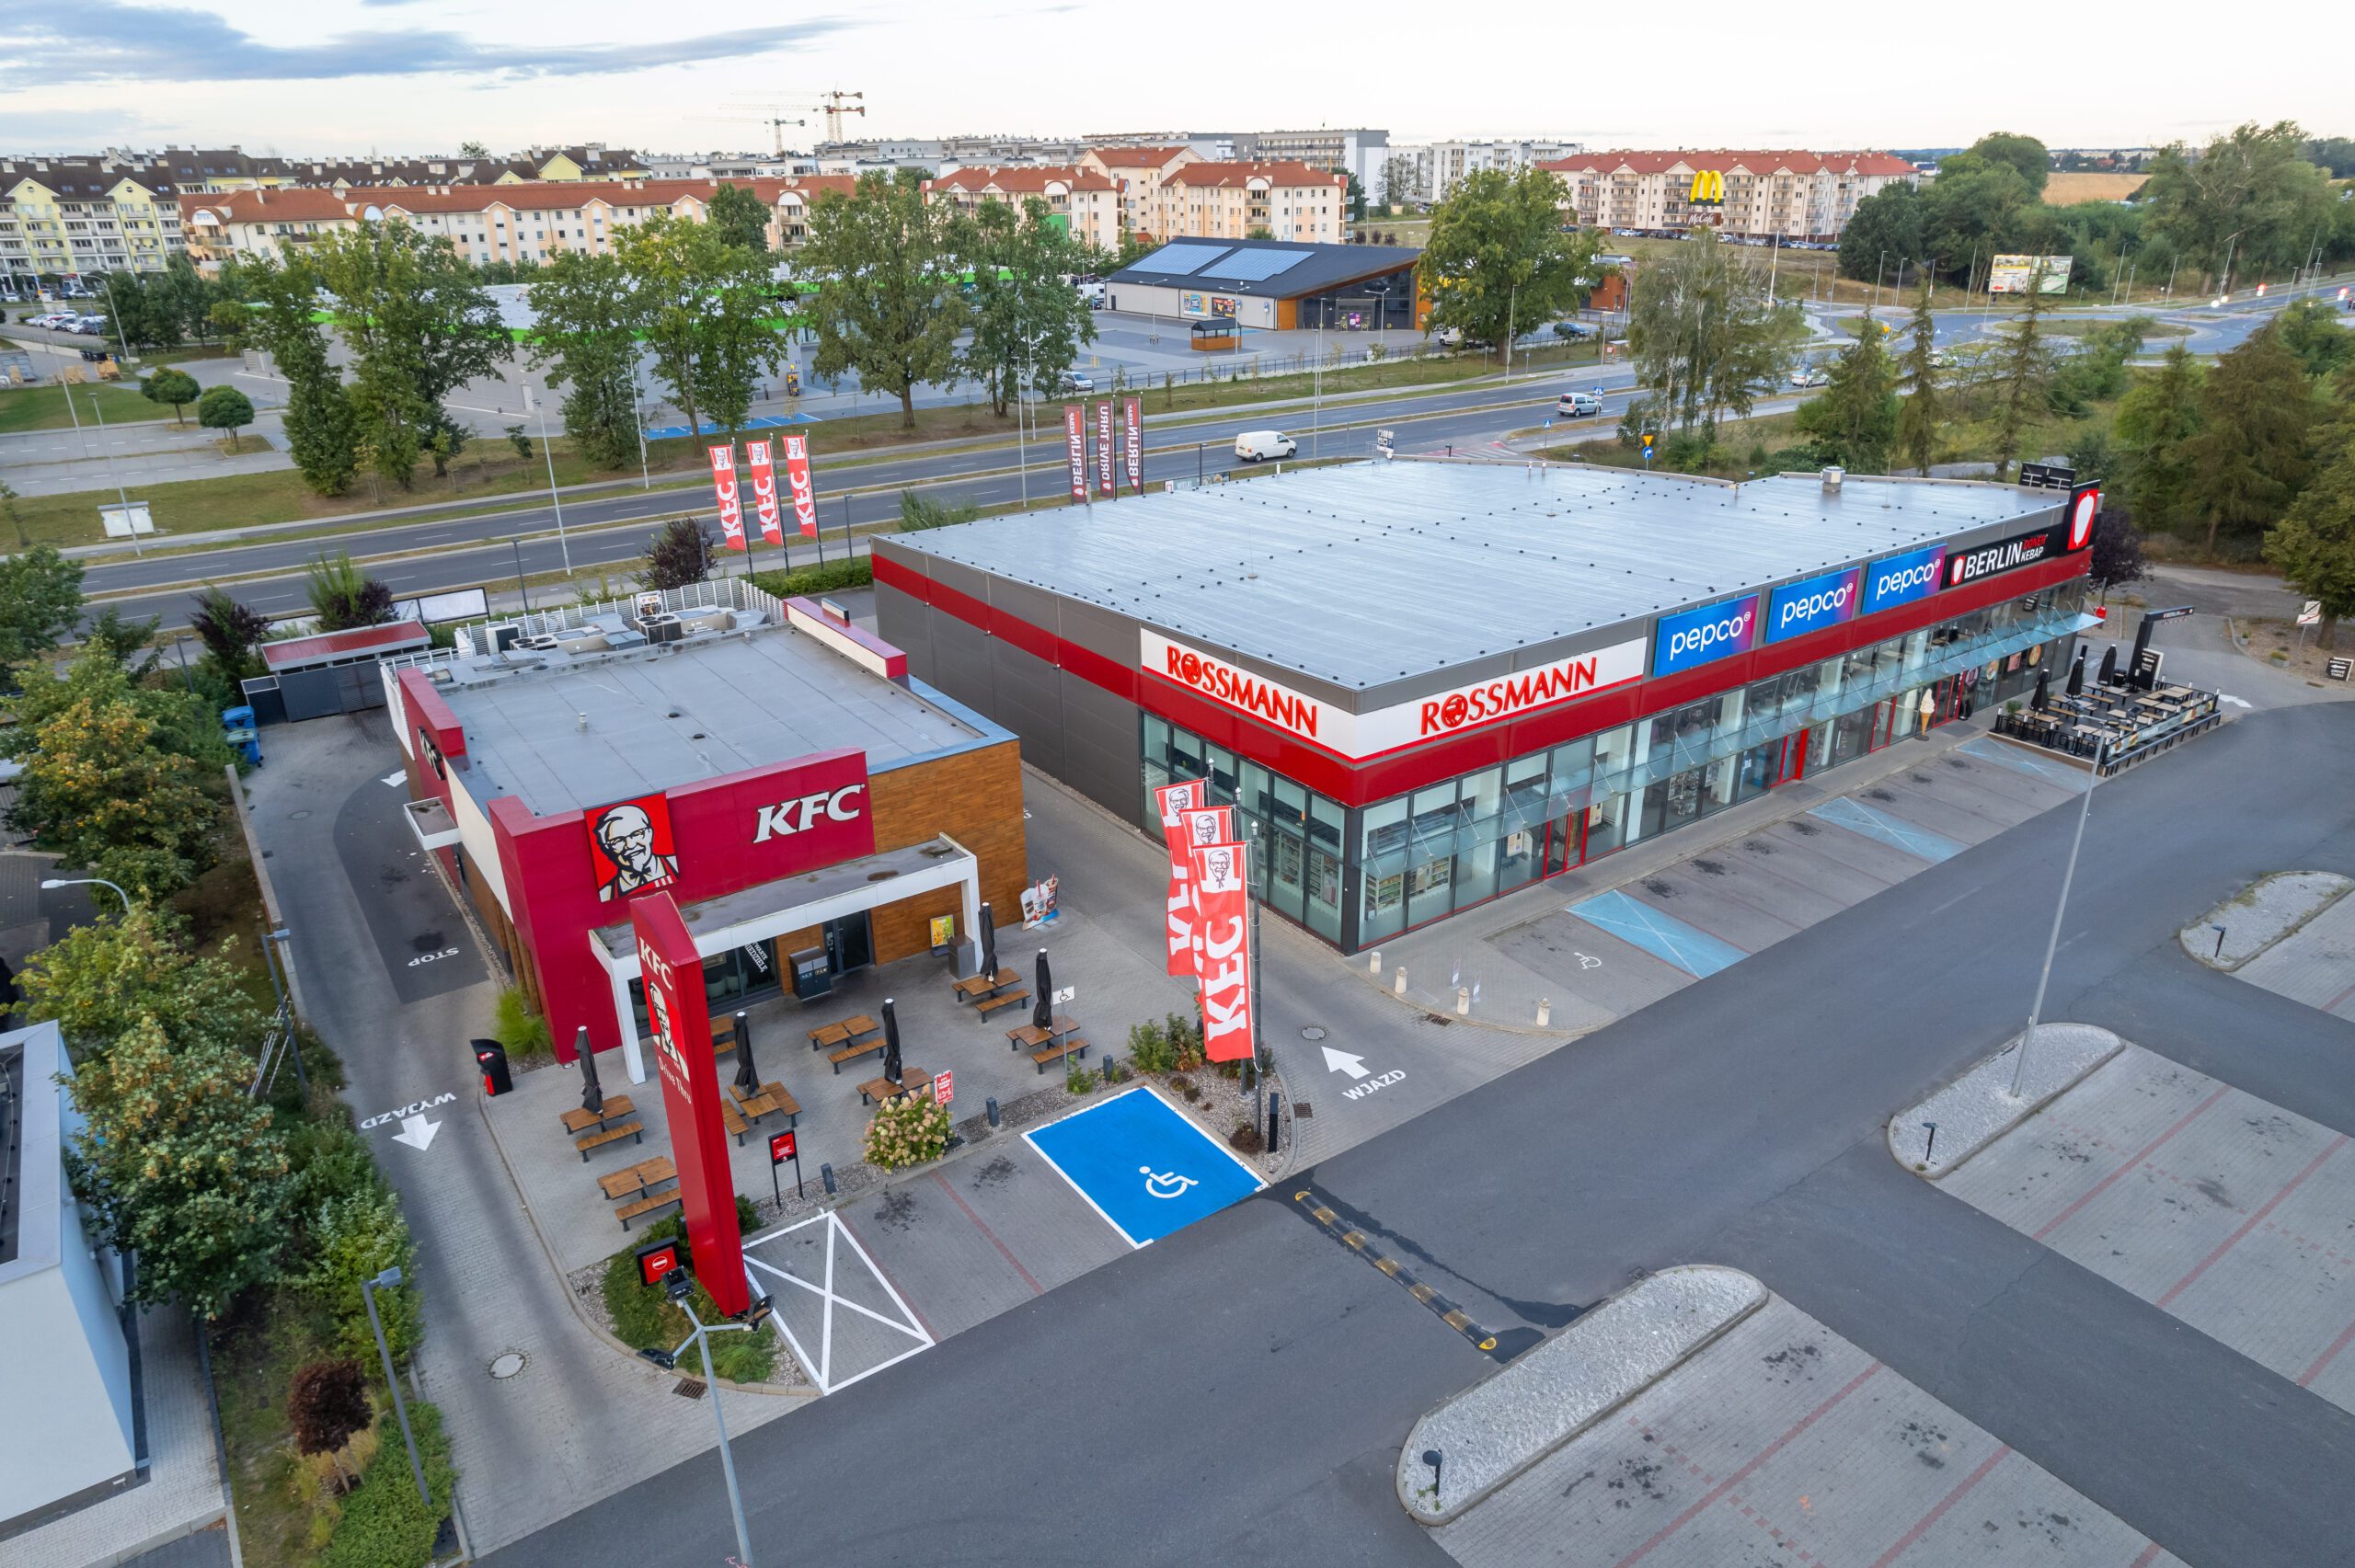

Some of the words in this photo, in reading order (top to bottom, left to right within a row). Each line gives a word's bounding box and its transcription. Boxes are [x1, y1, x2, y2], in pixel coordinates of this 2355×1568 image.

[1964, 541, 2023, 579] BERLIN
[2020, 546, 2044, 563] KEBAP
[1877, 562, 1935, 601] pepco
[1781, 587, 1846, 629] pepco
[1670, 615, 1744, 661] pepco
[1167, 646, 1317, 738] ROSSMANN
[1421, 657, 1597, 736] ROSSMANN
[753, 784, 862, 844] KFC
[408, 947, 460, 967] STOP
[638, 936, 673, 991] KFC
[753, 942, 769, 961] TWARTE
[658, 1055, 676, 1086] Drive
[675, 1076, 692, 1104] Thru
[1341, 1070, 1407, 1101] WJAZD
[361, 1092, 457, 1129] WYJAZD
